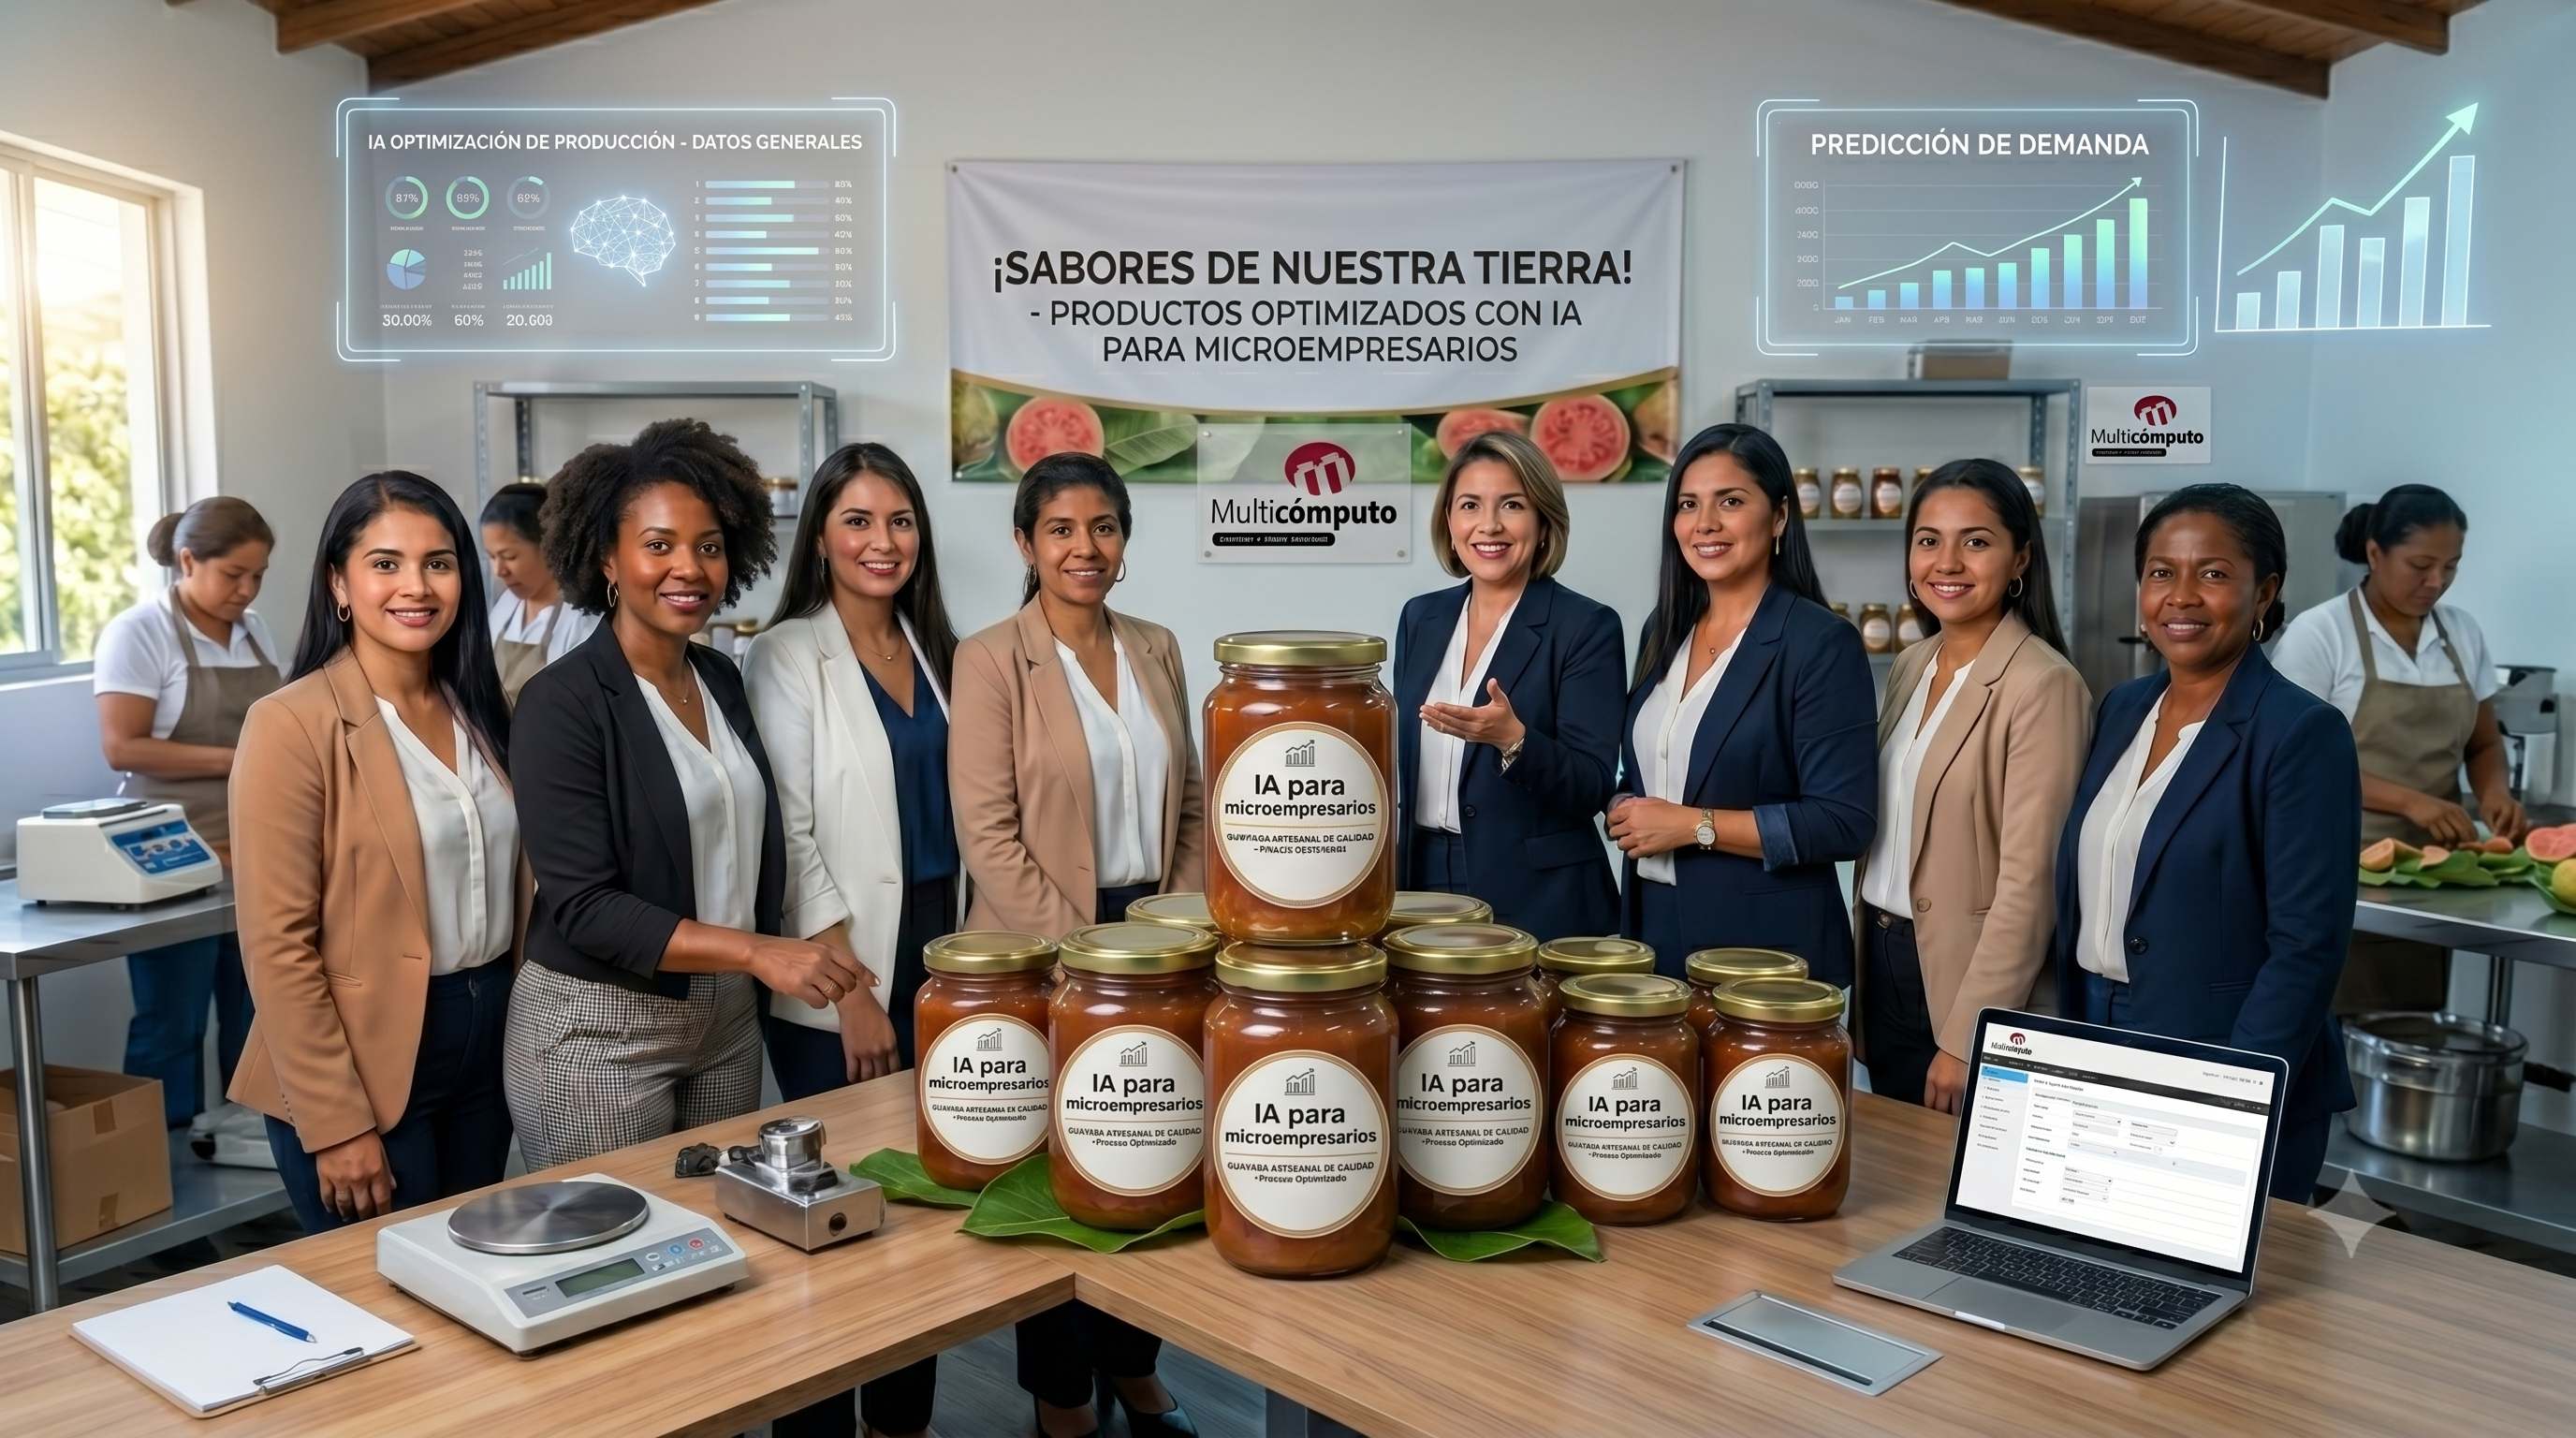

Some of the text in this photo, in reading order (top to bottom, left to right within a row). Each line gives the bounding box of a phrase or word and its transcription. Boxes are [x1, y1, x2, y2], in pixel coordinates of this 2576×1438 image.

[367, 134, 387, 151] IA
[390, 129, 521, 151] OPTIMIZACIÓN
[526, 134, 550, 151] DE
[554, 129, 676, 151] PRODUCCIÓN
[692, 134, 752, 151] DATOS
[756, 134, 862, 151] GENERALES
[1812, 127, 2149, 155] PREDICCIÓN DE DEMANDA
[993, 250, 1632, 294] ¡SABORES DE NUESTRA TIERRA!
[454, 314, 484, 327] 60%
[1050, 299, 1242, 327] PRODUCTOS
[1251, 299, 1466, 327] OPTIMIZADOS
[1475, 299, 1543, 327] CON
[1552, 299, 1581, 327] IA
[1104, 336, 1518, 362] PARA MICROEMPRESARIOS
[2091, 428, 2204, 448] Multicómputo
[1211, 497, 1398, 531] Multicómputo
[1255, 774, 1345, 800] IA para
[1225, 800, 1376, 819] microempresarios
[1323, 834, 1334, 843] DE
[954, 1056, 1027, 1078] IA para
[929, 1076, 1049, 1094] microempresarios
[1093, 1074, 1176, 1097] IA para
[1422, 1073, 1503, 1097] IA para
[1066, 1097, 1204, 1115] microempresarios
[1397, 1096, 1531, 1114] microempresarios
[1588, 1095, 1661, 1116] IA para
[1742, 1093, 1812, 1114] IA para
[1255, 1103, 1345, 1129] IA para
[1565, 1116, 1686, 1132] microempresarios
[1720, 1113, 1837, 1129] microempresarios
[1155, 1129, 1165, 1137] DE
[1167, 1127, 1202, 1137] CALIDAD
[1225, 1128, 1377, 1149] microempresarios
[1496, 1126, 1530, 1136] CALIDAD
[1227, 1162, 1268, 1172] GUAYABA
